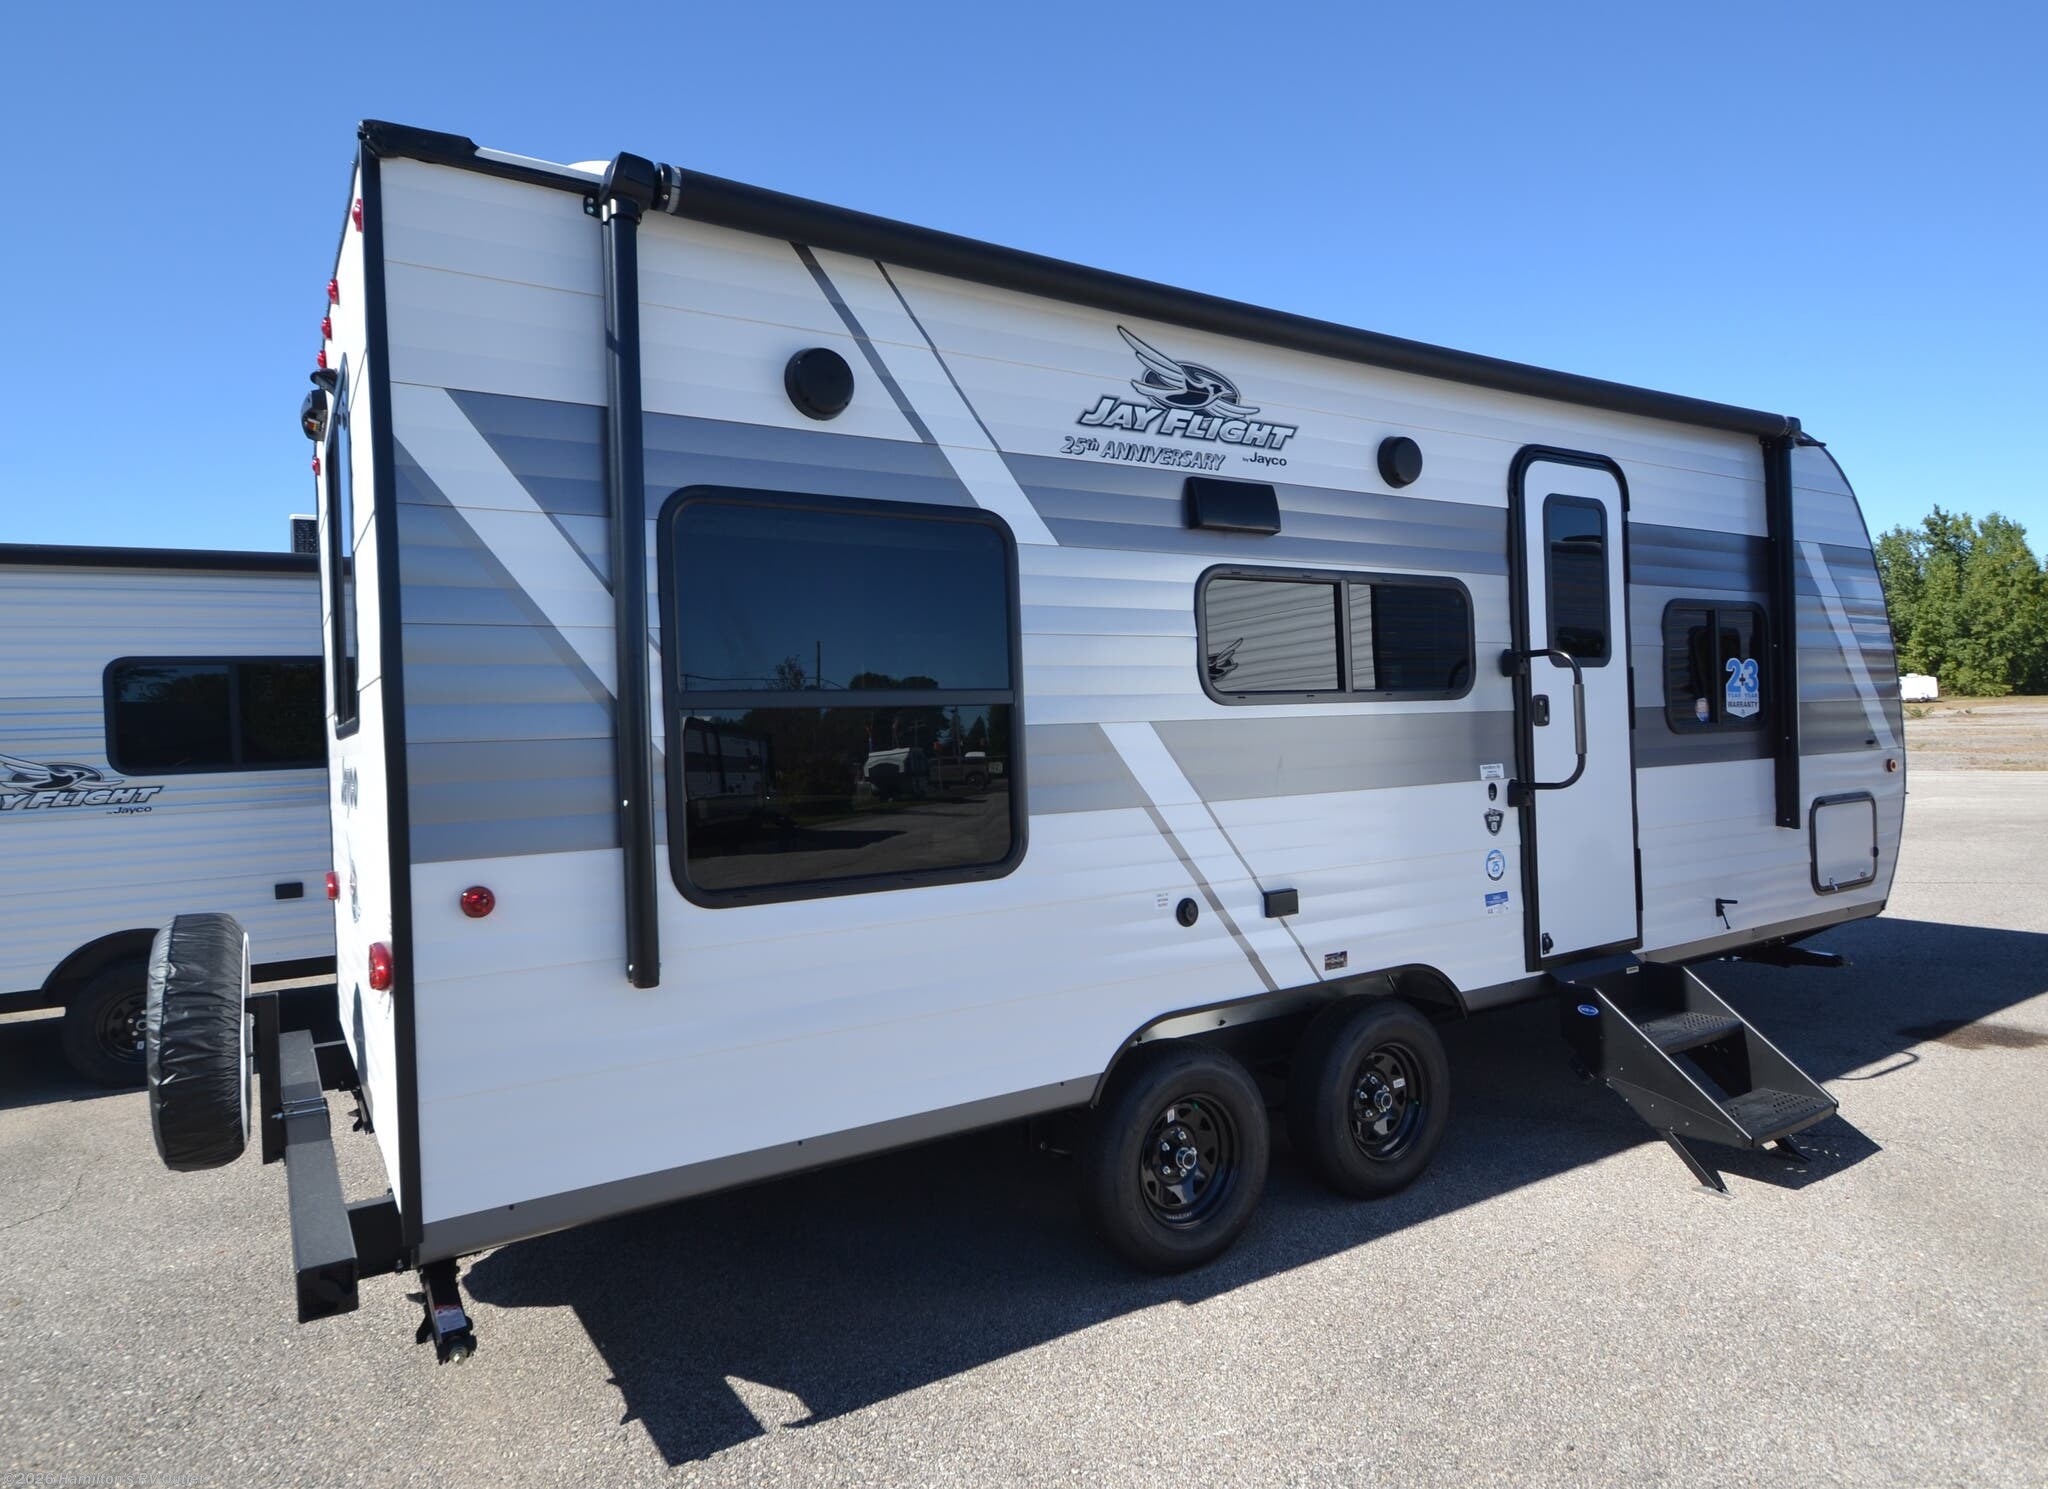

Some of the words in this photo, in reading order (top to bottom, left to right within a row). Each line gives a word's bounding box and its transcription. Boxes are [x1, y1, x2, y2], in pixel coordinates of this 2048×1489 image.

[1060, 435, 1100, 455] 25th
[1101, 440, 1226, 471] ANNIVERSARY
[1250, 451, 1287, 467] Jayco
[113, 806, 152, 815] Jayco
